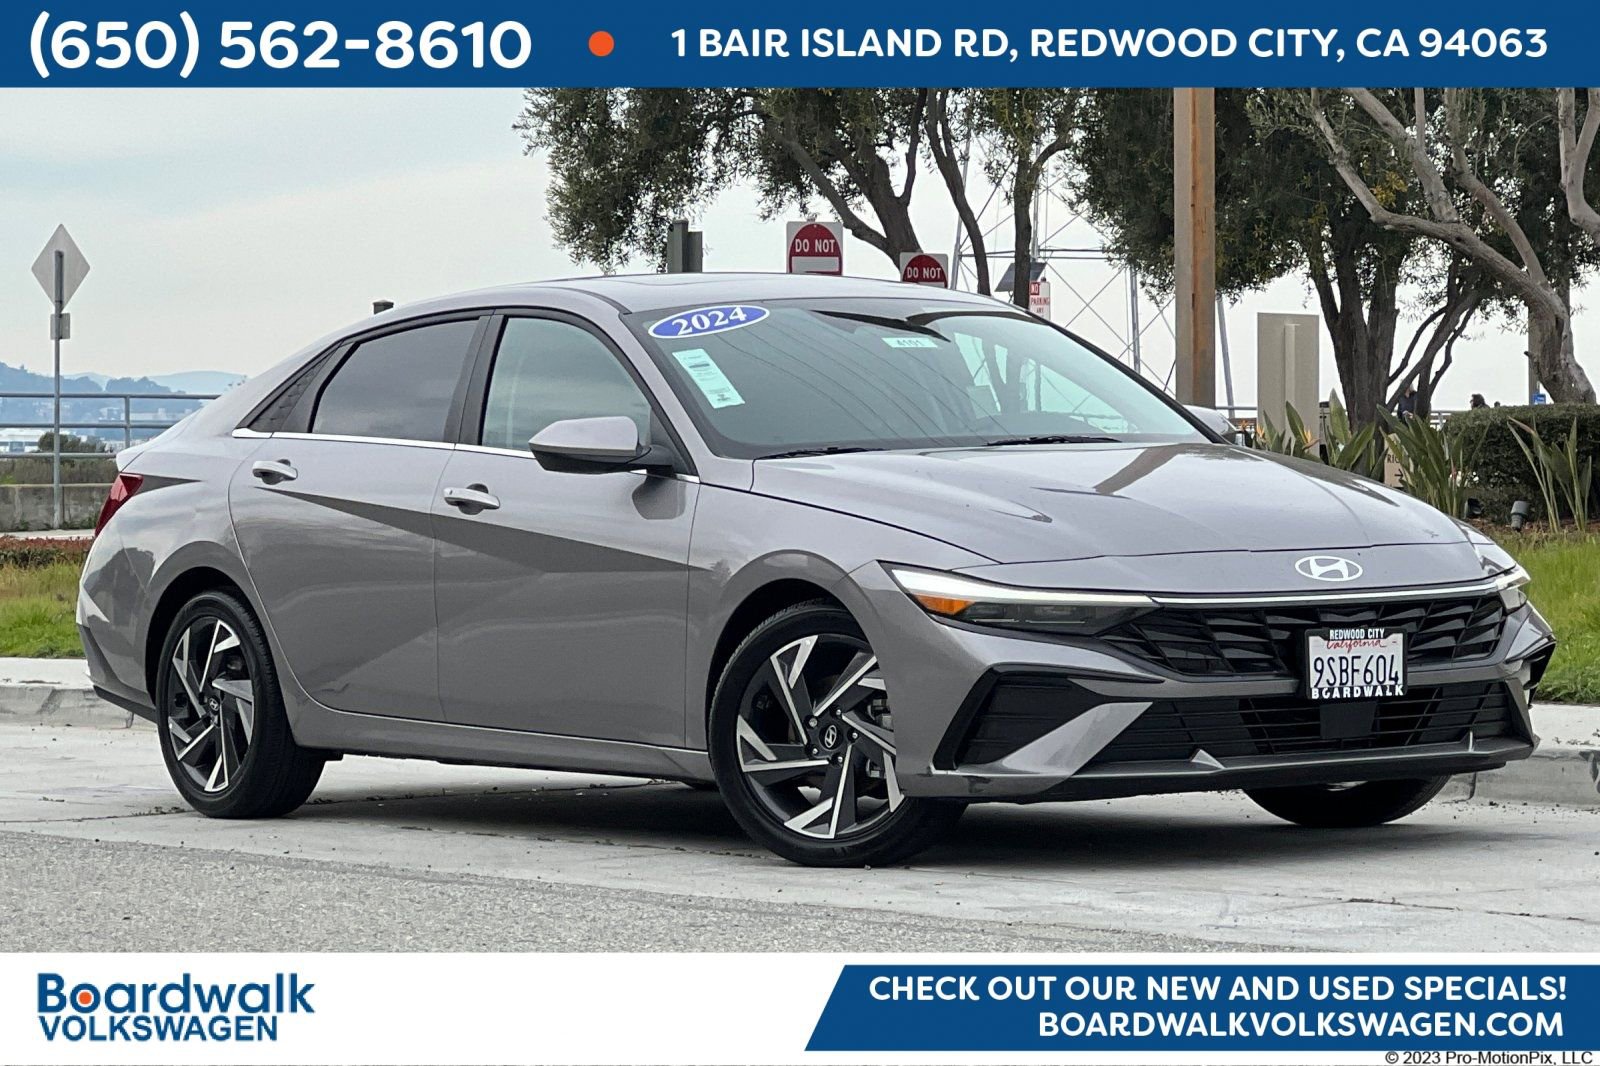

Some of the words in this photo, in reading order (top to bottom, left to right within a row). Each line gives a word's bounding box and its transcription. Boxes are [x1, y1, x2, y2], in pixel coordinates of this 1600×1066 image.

[795, 239, 810, 253] DO
[814, 239, 835, 253] NOT
[907, 267, 919, 278] DO
[922, 267, 941, 279] NOT
[672, 306, 748, 336] 2024
[1329, 629, 1365, 640] REDWOOD
[1367, 628, 1385, 639] CITY
[1326, 639, 1387, 653] California
[1313, 654, 1400, 688] 9SBF604
[1311, 685, 1404, 699] BOARDWALK
